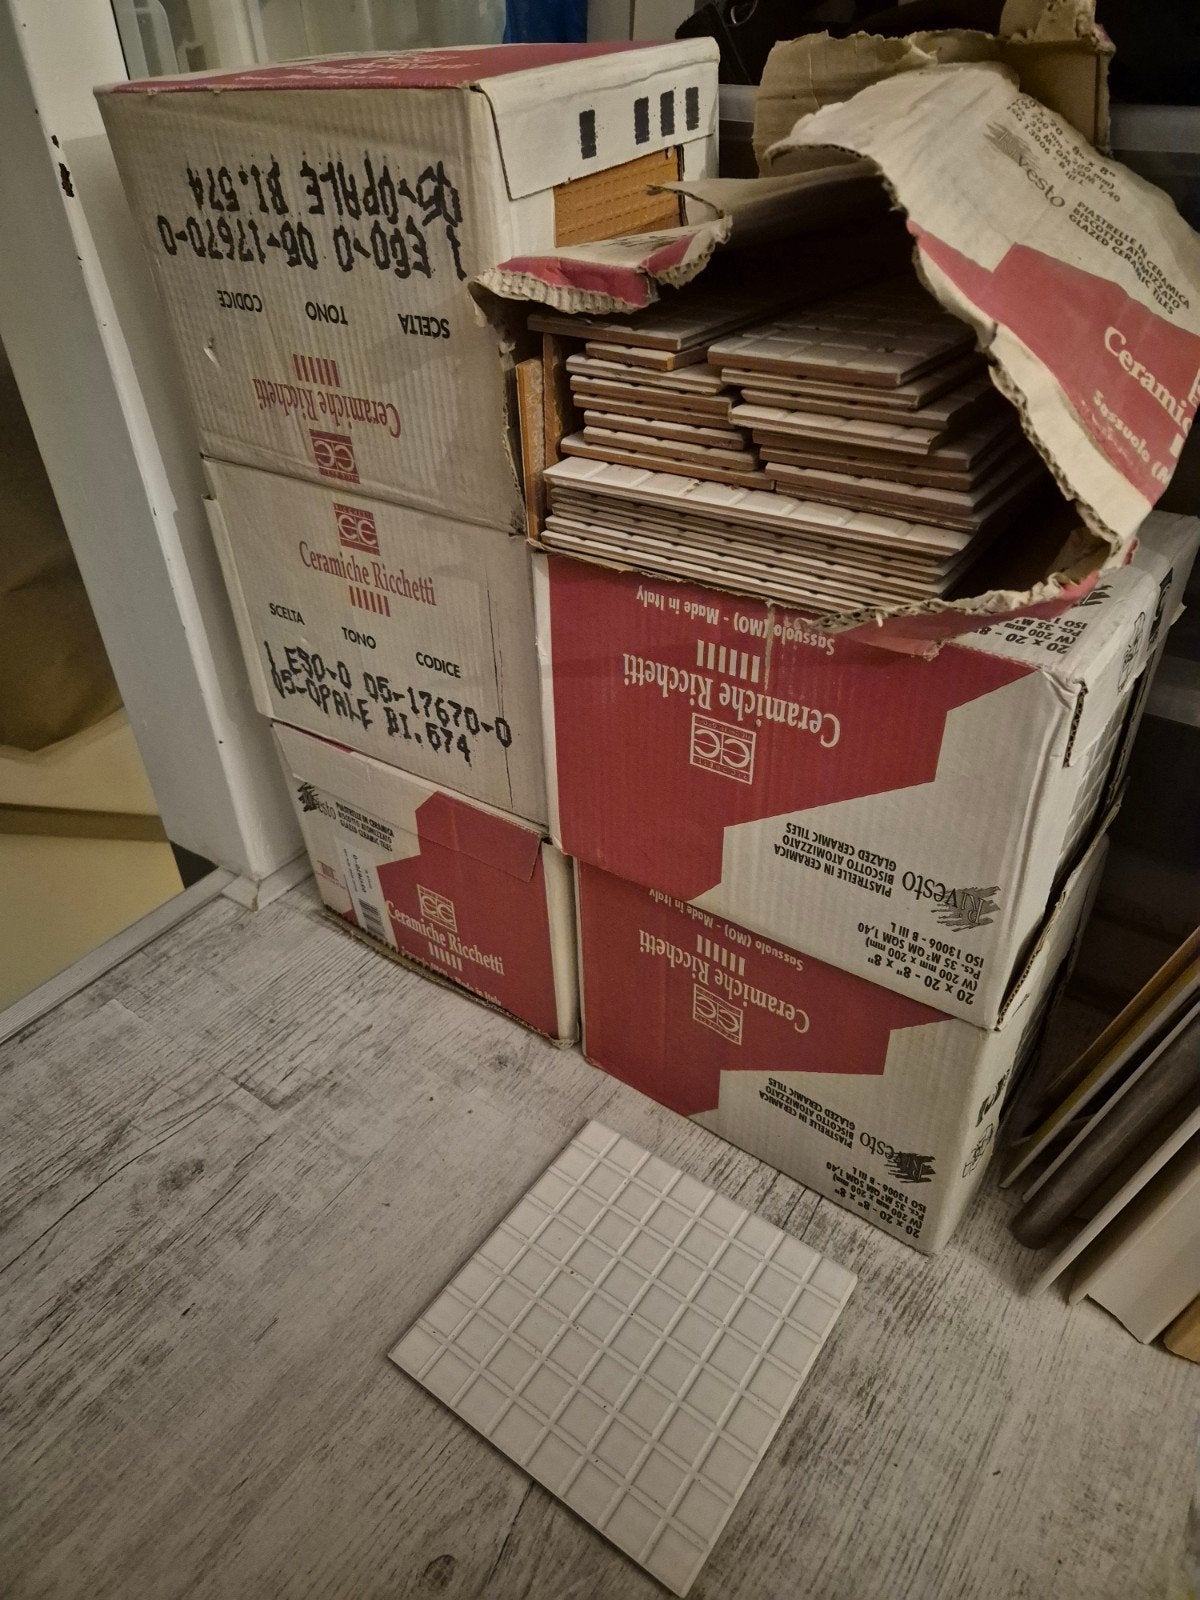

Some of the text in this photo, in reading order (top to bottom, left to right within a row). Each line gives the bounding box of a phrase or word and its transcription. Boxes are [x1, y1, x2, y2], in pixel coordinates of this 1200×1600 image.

[1072, 207, 1180, 308] BISCOTTO ATOMIZZATO
[1077, 201, 1190, 309] PIASTRELLE IN CERAMICA
[1069, 214, 1174, 314] GLAZED CERAMIC TILES
[217, 290, 450, 339] SCELTA TONO CODICE
[253, 379, 401, 438] Ceramiche Ricchetti
[1093, 389, 1150, 463] Sassuolo
[299, 541, 437, 606] Ceramiche Ricchetti
[636, 585, 664, 611] Italy
[669, 597, 680, 611] in
[684, 601, 719, 625] Made
[734, 612, 767, 639] (MO)
[1003, 622, 1076, 644] (W 200 mm
[1035, 621, 1054, 630] 35
[1058, 626, 1082, 637] Pcs.
[1063, 620, 1087, 629] ISO
[269, 602, 461, 678] SCELTA TONO CODICE
[774, 626, 836, 656] Sassuolo
[1005, 633, 1027, 643] 20
[1031, 638, 1044, 646] x
[1046, 642, 1070, 654] 20
[623, 653, 841, 748] Ceramiche Ricchetti
[785, 822, 896, 871] GLAZED CERAMIC TILES
[782, 834, 894, 885] BISCOTTO ATOMIZZATO
[773, 843, 892, 897] PIASTRELLE IN CERAMICA
[901, 870, 984, 925] Rivesto
[674, 899, 684, 914] in
[686, 905, 714, 928] Made
[857, 922, 878, 939] 1,40
[890, 921, 896, 933] L
[898, 925, 909, 938] III
[386, 900, 447, 946] Ceramiche
[449, 936, 505, 975] Ricchetti
[724, 924, 751, 948] (MO)
[882, 931, 905, 949] SQM
[911, 931, 919, 942] B
[755, 940, 804, 972] Sassuolo
[907, 942, 925, 957] QM
[928, 937, 961, 959] 13006
[864, 936, 977, 991] (W 200 mm x 200 mm)
[867, 953, 882, 966] 8"
[885, 957, 894, 968] x
[943, 957, 957, 970] 35
[964, 953, 984, 968] ISO
[895, 966, 911, 978] 8"
[960, 963, 981, 980] Pcs.
[639, 929, 810, 1034] Ceramiche Ricchetti
[923, 974, 941, 991] 20
[944, 982, 953, 993] x
[956, 988, 974, 1005] 20
[768, 1077, 855, 1130] GLAZED CERAMIC TILES
[758, 1090, 852, 1148] PIASTRELLE IN CERAMICA
[765, 1085, 854, 1140] BISCOTTO ATOMIZZATO
[825, 1161, 843, 1176] 1,40
[852, 1166, 857, 1175] L
[845, 1171, 864, 1188] SQM
[869, 1176, 875, 1185] B
[850, 1184, 866, 1198] 200
[882, 1183, 908, 1203] 13006
[890, 1207, 907, 1221] 200
[894, 1200, 906, 1211] 35
[910, 1199, 926, 1213] ISO
[879, 1210, 893, 1224] 20
[895, 1218, 903, 1227] x
[908, 1217, 922, 1229] (W
[905, 1225, 920, 1238] 20
